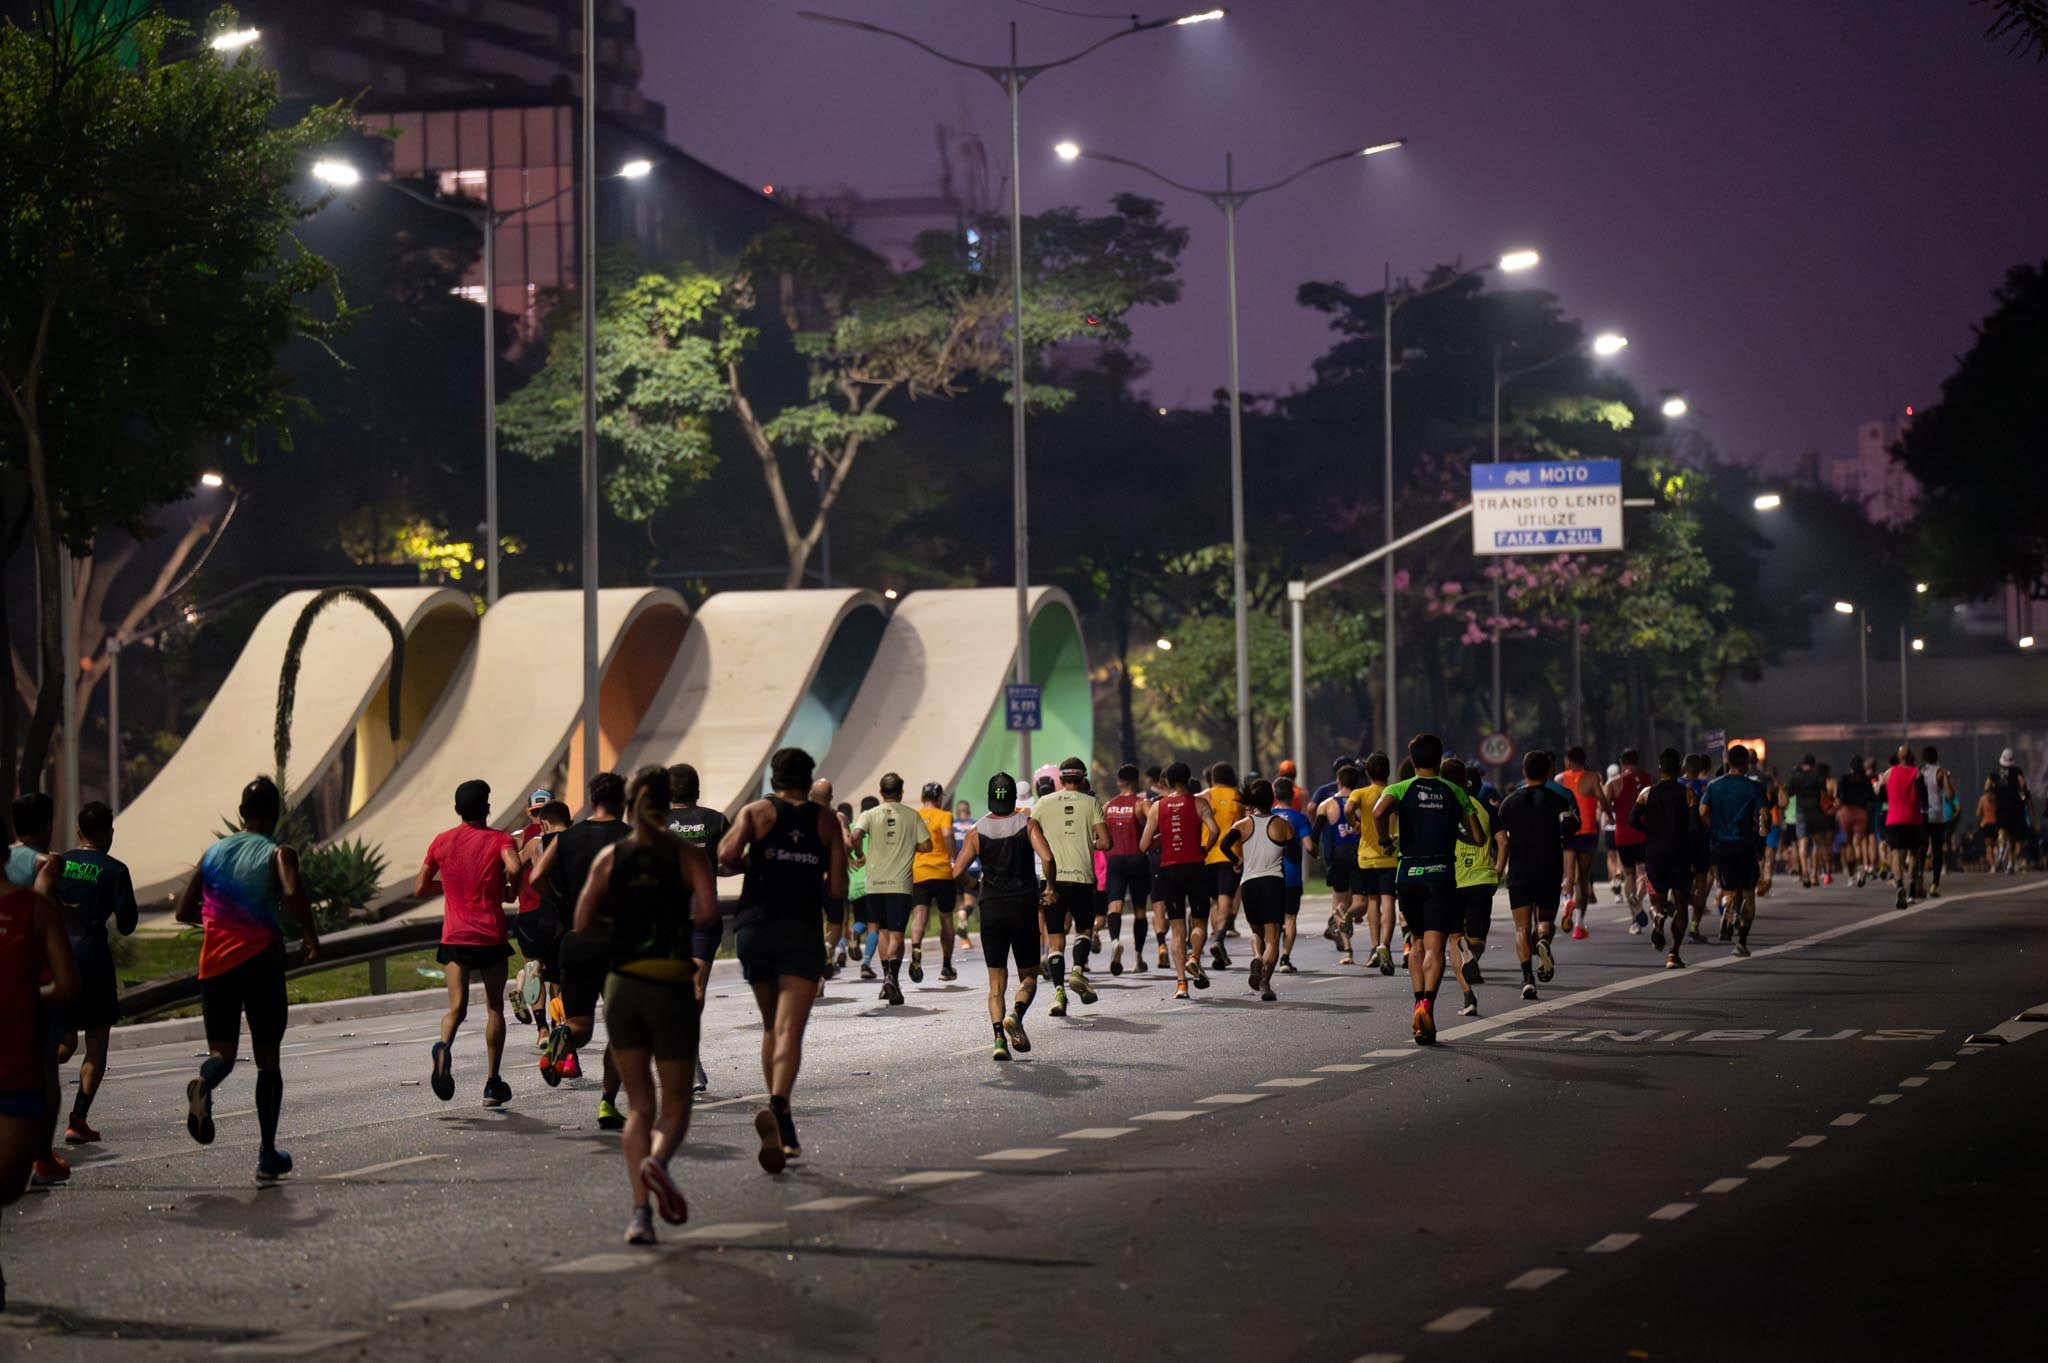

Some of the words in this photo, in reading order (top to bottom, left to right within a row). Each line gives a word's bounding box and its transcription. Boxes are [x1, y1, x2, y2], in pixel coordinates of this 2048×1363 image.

[1540, 466, 1589, 482] MOTO
[1566, 493, 1616, 508] LENTO
[1518, 513, 1577, 527] UTILIZE
[1498, 531, 1547, 546] FAIXA
[1555, 529, 1600, 544] AZUL
[1107, 806, 1134, 814] ATLETA
